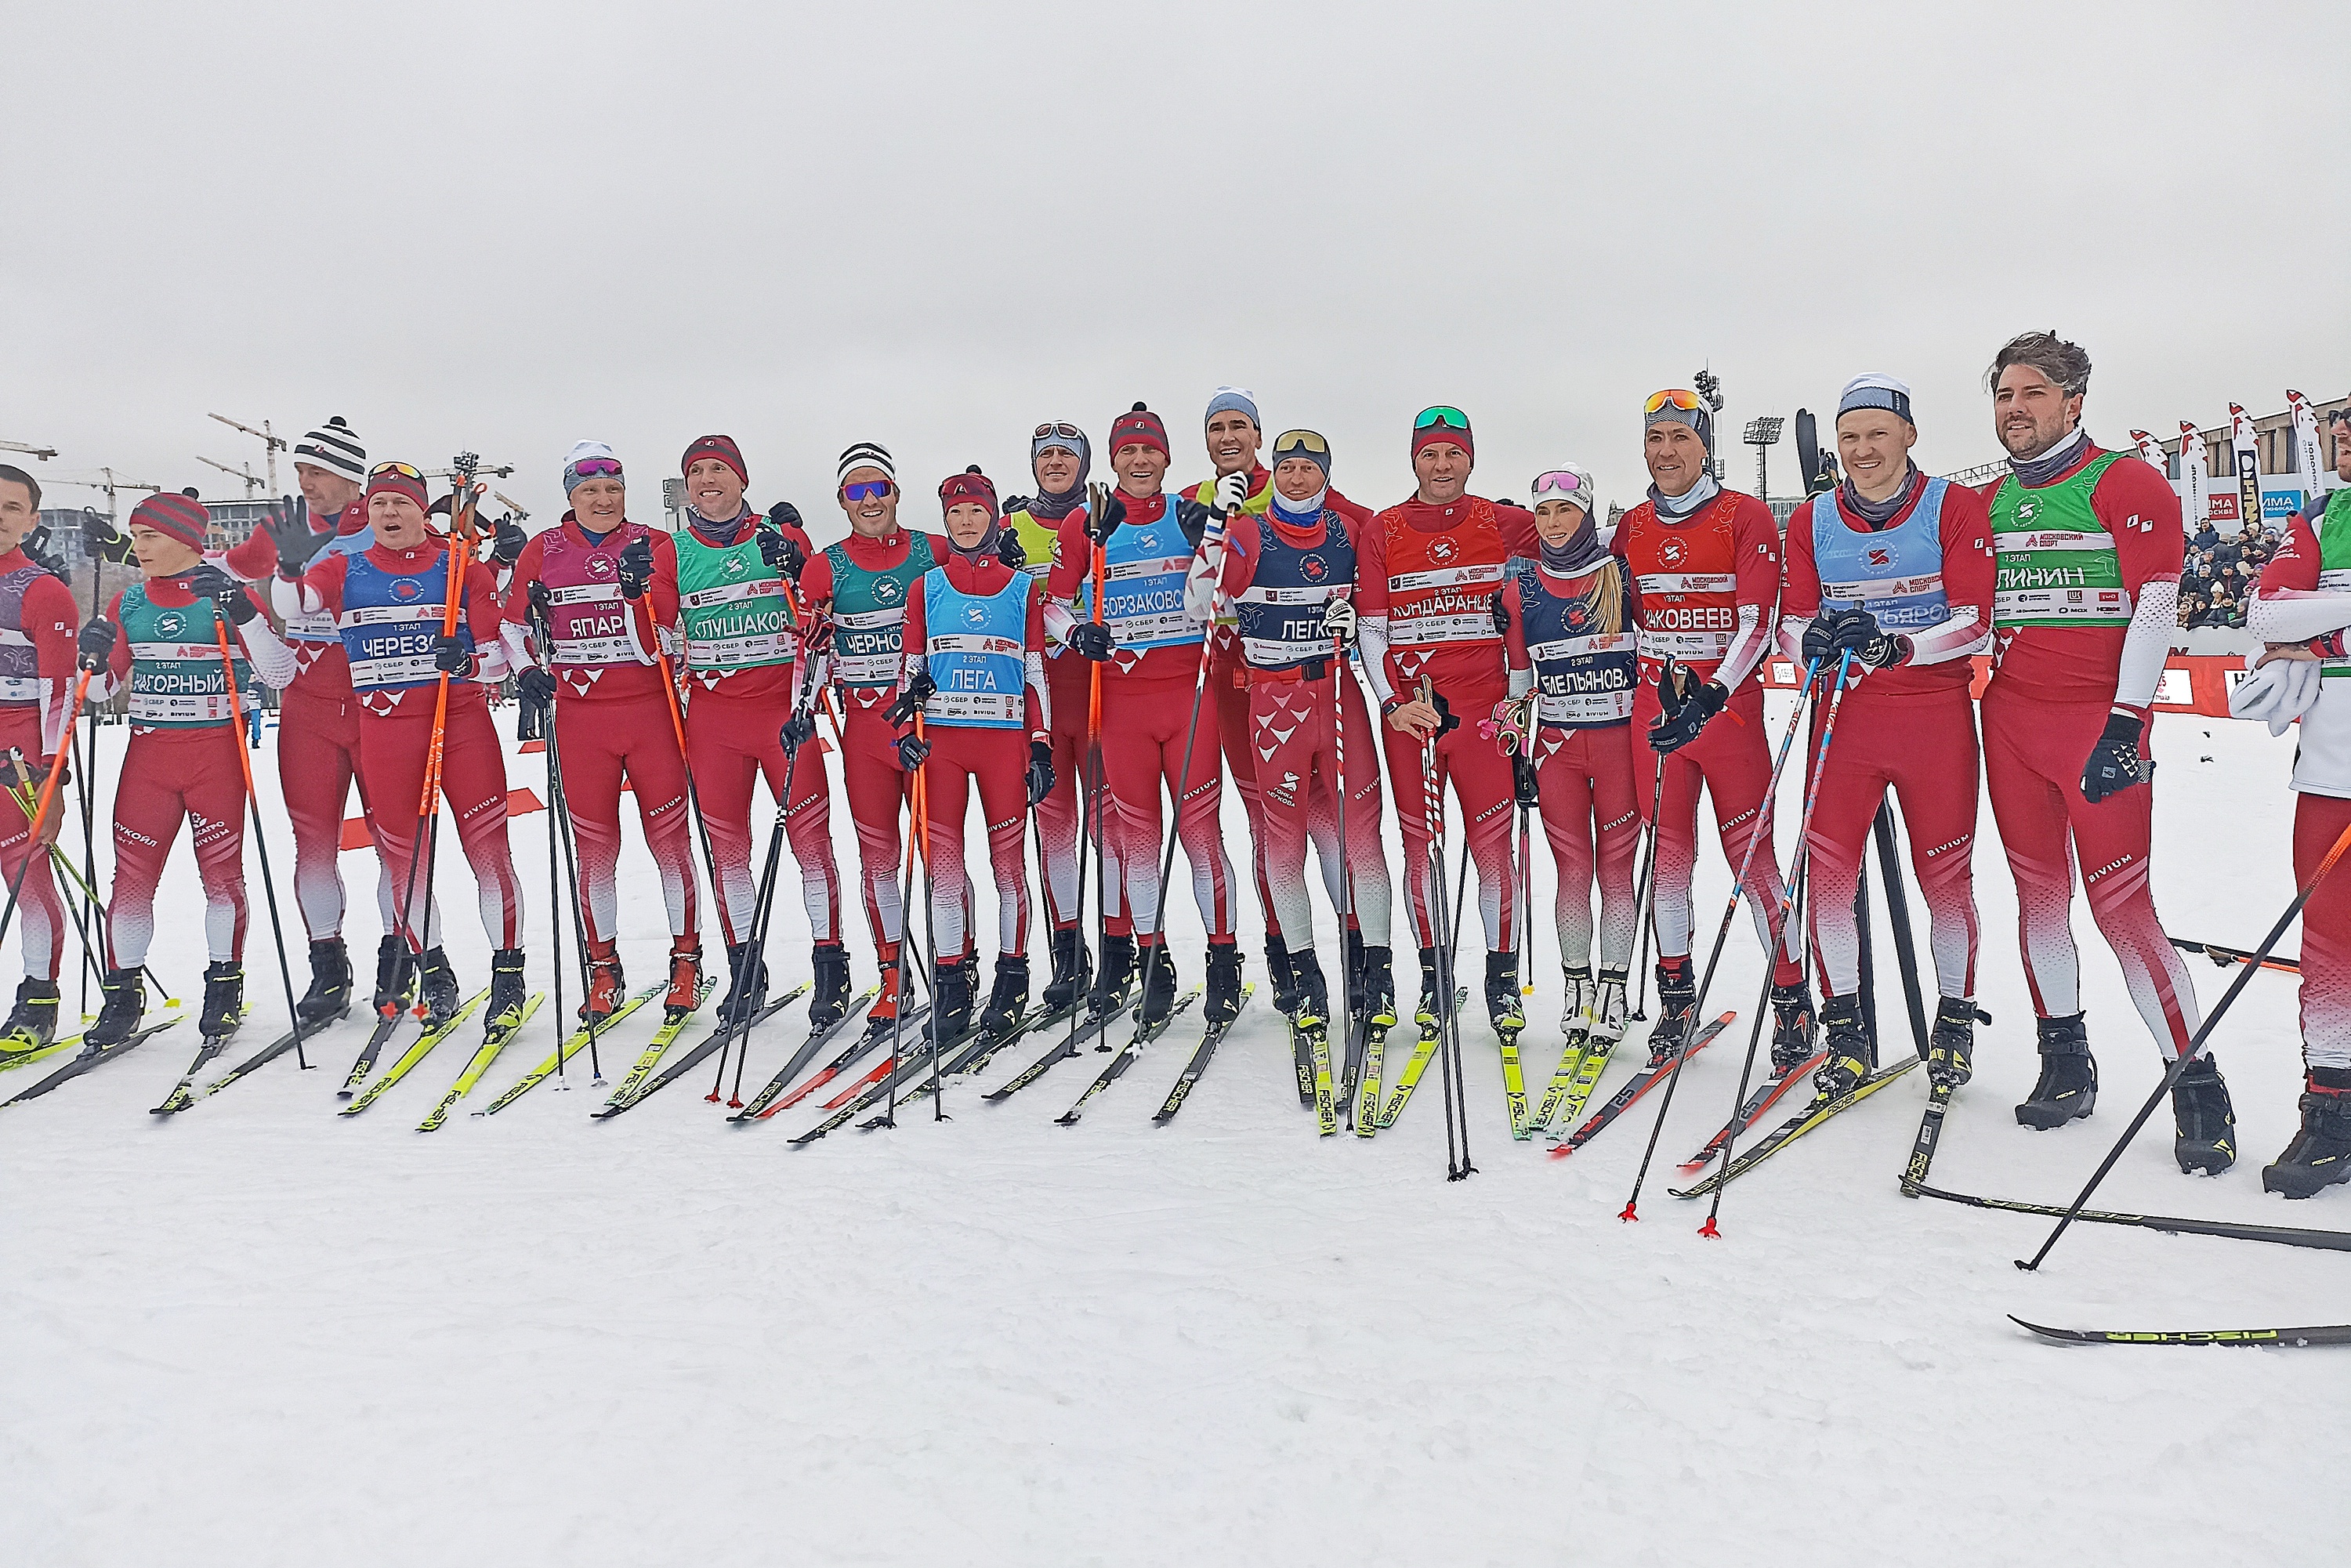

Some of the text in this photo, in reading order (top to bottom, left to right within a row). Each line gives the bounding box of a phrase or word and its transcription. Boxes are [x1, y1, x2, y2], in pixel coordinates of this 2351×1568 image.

[1148, 577, 1168, 586] ЭТАП
[1996, 567, 2085, 588] ЛИНИН
[1441, 587, 1462, 596] ЭТАП
[1910, 585, 1930, 593] СПОРТ
[735, 601, 753, 610] ЭТАП
[570, 615, 624, 637] ЯПАР
[846, 633, 903, 654] ЧЕРНО
[1576, 657, 1593, 665] ЭТАП
[950, 669, 997, 690] ЛЕГА
[1183, 778, 1217, 801] BIVIUM
[1266, 790, 1295, 808] ЛЕГКОВА
[1273, 787, 1293, 800] ГОНКА
[463, 795, 498, 820] BIVIUM
[1476, 798, 1510, 823] BIVIUM
[1603, 809, 1635, 831] BIVIUM
[1721, 808, 1756, 832] BIVIUM
[1925, 833, 1970, 857] BIVIUM
[2088, 853, 2133, 884] BIVIUM
[1003, 1063, 1045, 1093] FISCHER
[1297, 1064, 1313, 1095] FISCHER
[748, 1081, 782, 1114] FISCHER
[1165, 1078, 1193, 1113] FISCHER
[1318, 1089, 1333, 1123] FISCHER
[1827, 1092, 1856, 1117] FISCHER
[817, 1096, 870, 1133] FISCHER
[2313, 1155, 2336, 1166] FISCHER
[2106, 1329, 2278, 1342] FISCHER
